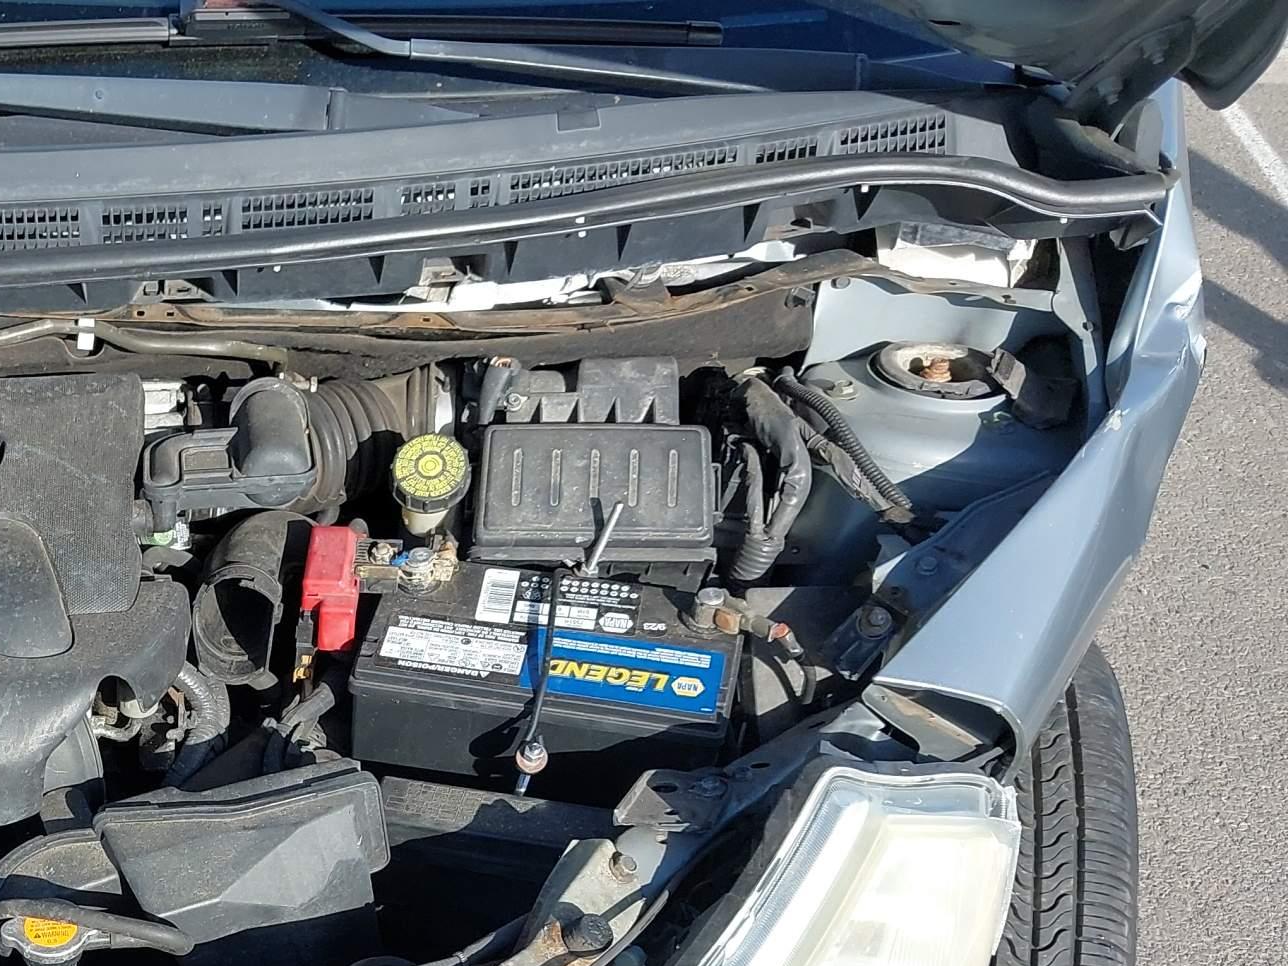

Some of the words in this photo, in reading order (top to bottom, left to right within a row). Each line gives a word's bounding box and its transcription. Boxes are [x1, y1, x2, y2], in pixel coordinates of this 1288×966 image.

[642, 622, 667, 631] 9/23
[396, 659, 479, 677] DANGER/POISON
[548, 659, 670, 692] LEGEND
[675, 681, 699, 693] NAPA
